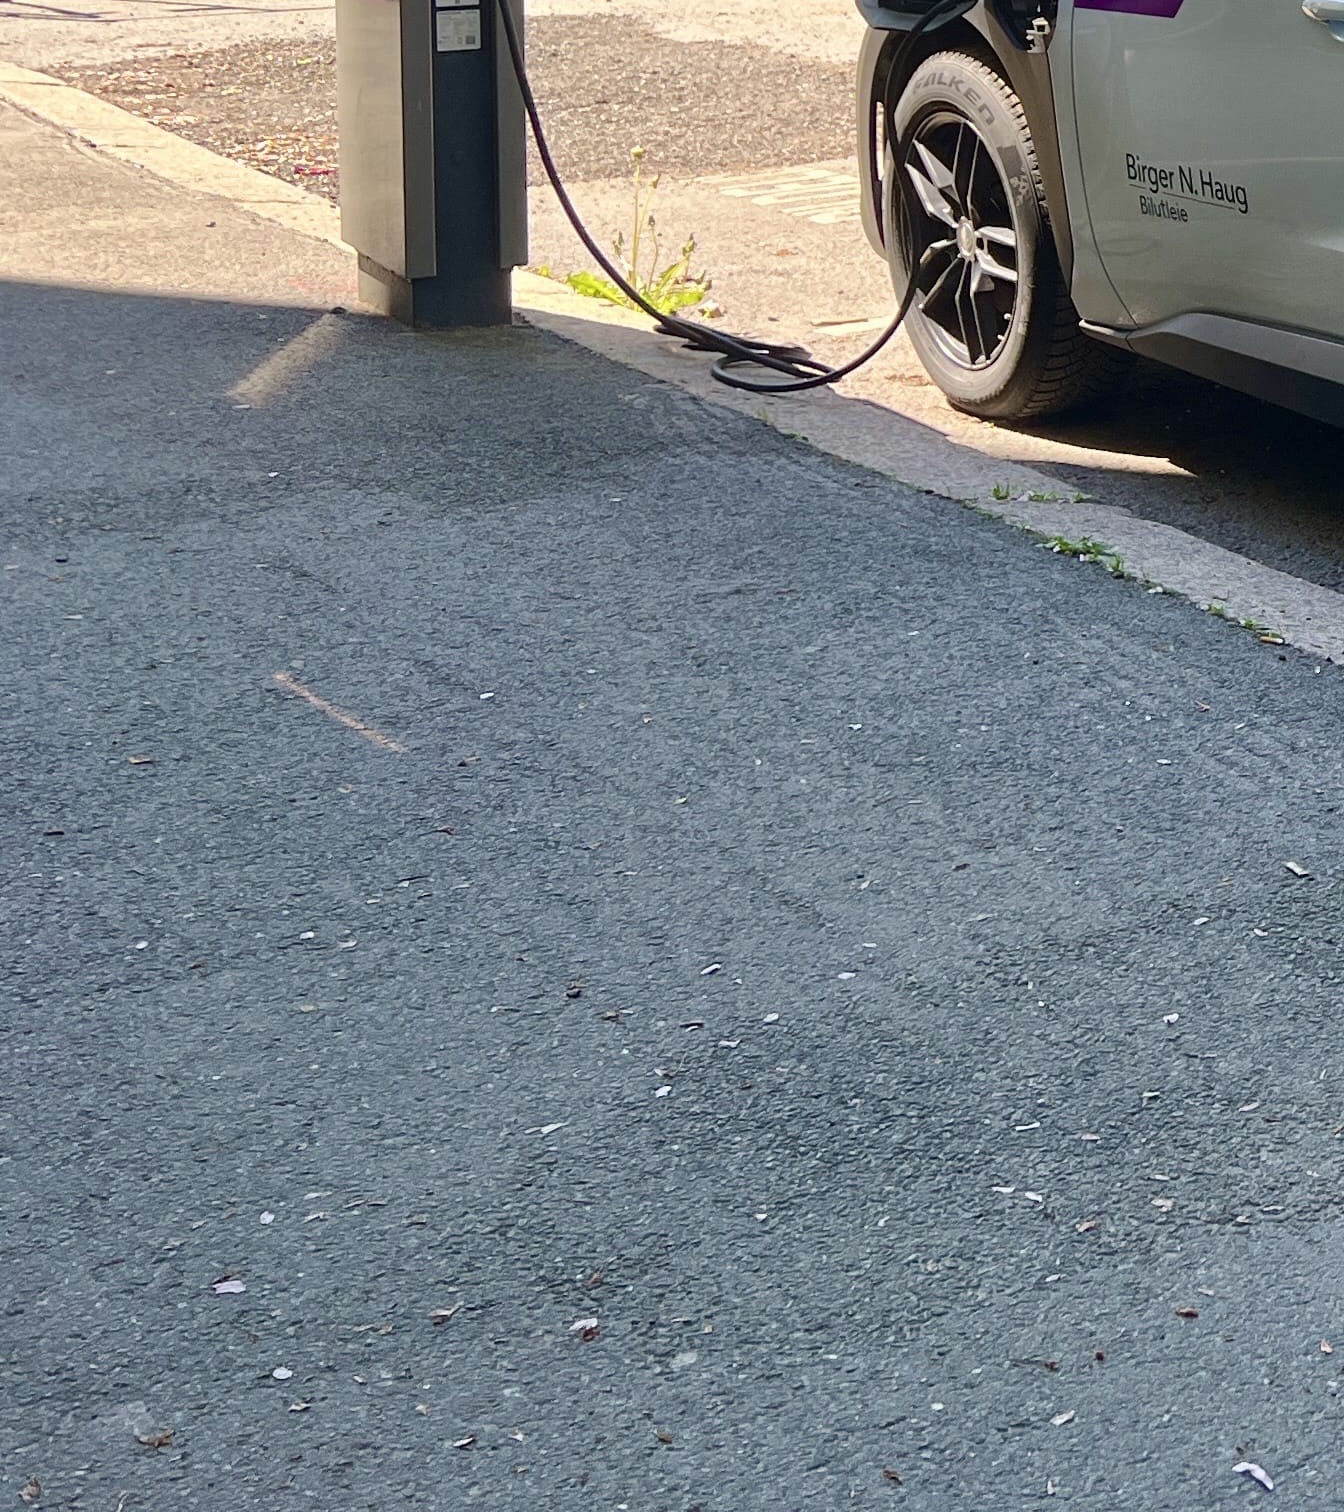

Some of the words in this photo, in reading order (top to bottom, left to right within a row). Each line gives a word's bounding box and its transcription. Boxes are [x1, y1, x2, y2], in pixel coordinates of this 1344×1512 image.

[1126, 153, 1174, 194] Birger
[1178, 165, 1198, 195] N.
[1199, 168, 1249, 214] Haug
[1139, 195, 1189, 223] Bilutleie
